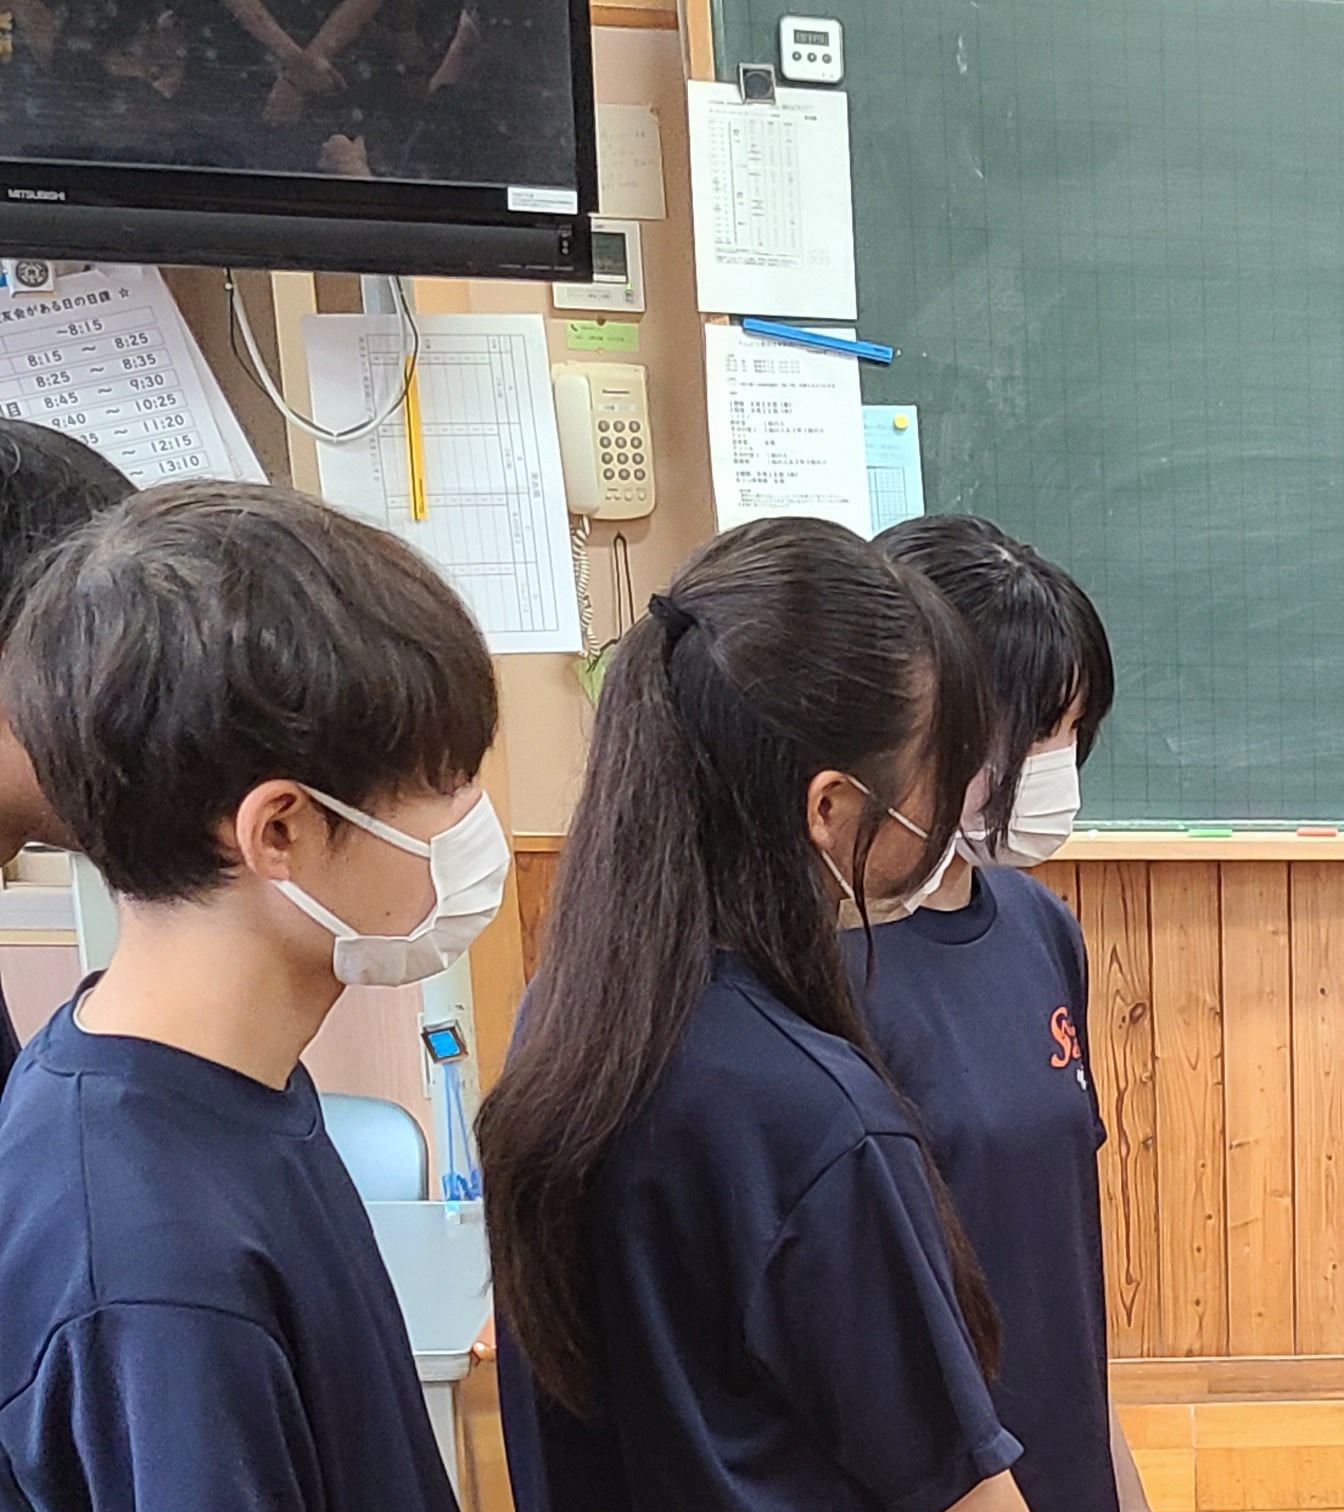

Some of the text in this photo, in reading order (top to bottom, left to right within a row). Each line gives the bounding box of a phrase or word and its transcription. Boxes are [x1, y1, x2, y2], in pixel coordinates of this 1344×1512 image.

[0, 290, 111, 324] 友会がある日の日課
[27, 350, 63, 368] 8:15
[114, 333, 149, 350] 8:25
[36, 373, 71, 389] 8:25
[122, 354, 157, 370] 8:35
[44, 392, 79, 409] 8:45
[130, 374, 164, 391] 9:30
[52, 413, 87, 430] 9:40
[135, 394, 177, 412] 10:25
[143, 415, 184, 433] 11:20
[151, 436, 193, 453] 12:15
[159, 456, 200, 474] 13:10
